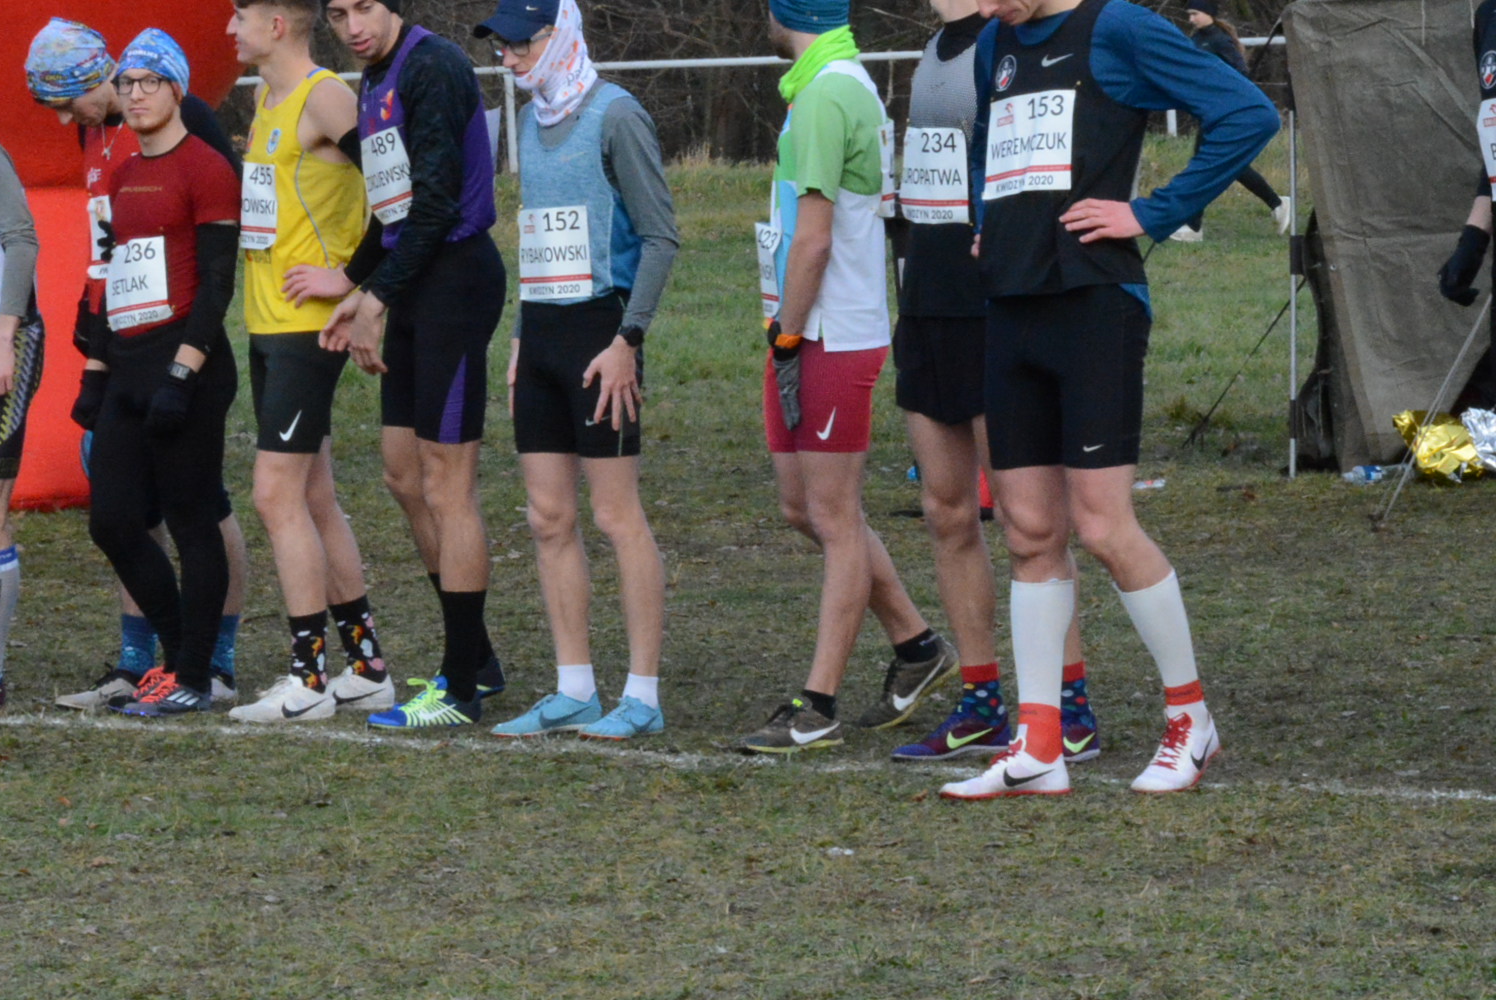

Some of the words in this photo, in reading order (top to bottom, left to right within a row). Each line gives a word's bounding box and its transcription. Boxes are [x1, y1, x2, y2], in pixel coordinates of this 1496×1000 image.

[1027, 94, 1065, 121] 153
[370, 132, 396, 157] 489
[920, 132, 957, 154] 234
[991, 132, 1067, 161] WEREMCZUK
[249, 166, 273, 187] 455
[1028, 175, 1054, 186] 2020
[241, 198, 276, 215] OWSKI
[931, 209, 954, 220] 2020
[542, 210, 581, 232] 152
[123, 241, 156, 264] 236
[520, 244, 588, 264] RYBAKOWSKI
[111, 274, 150, 296] SETLAK
[557, 284, 581, 295] 2020
[138, 310, 159, 322] 2020
